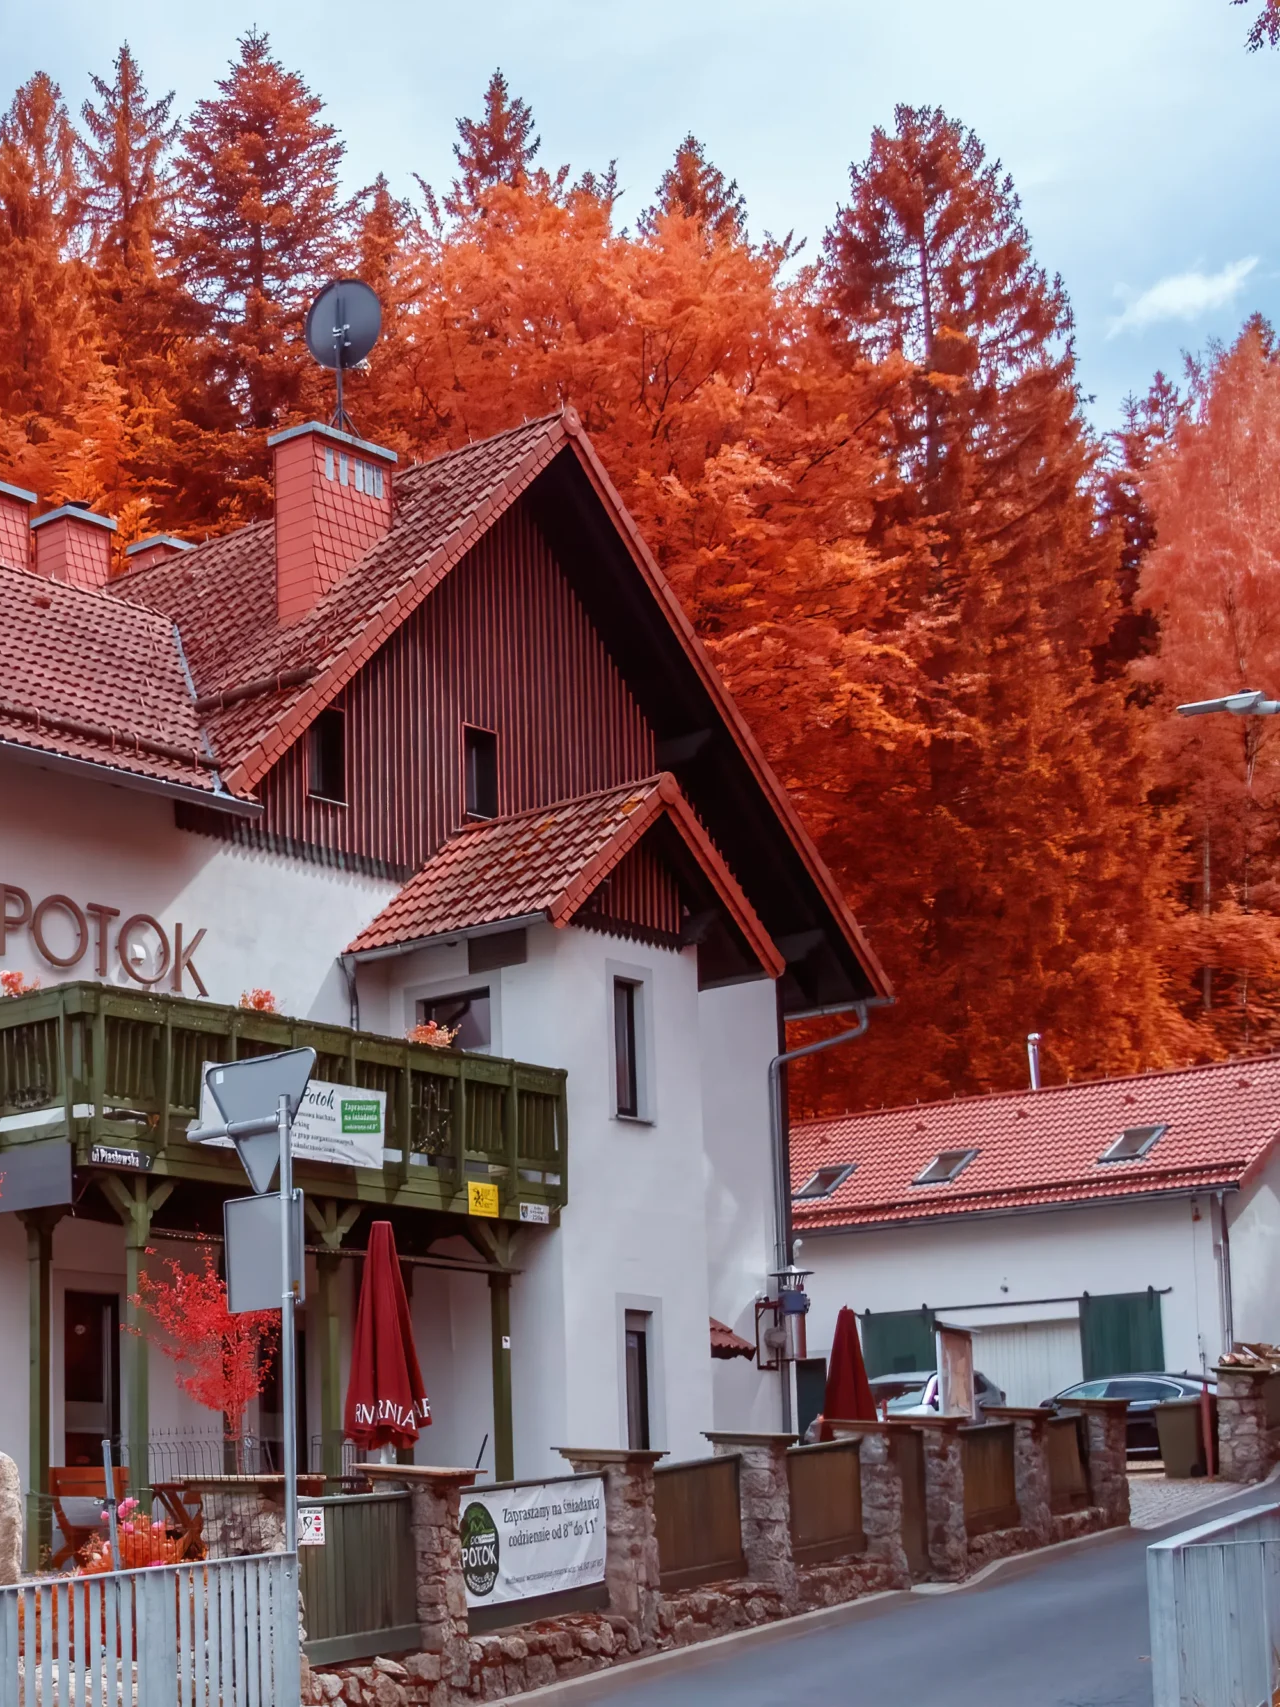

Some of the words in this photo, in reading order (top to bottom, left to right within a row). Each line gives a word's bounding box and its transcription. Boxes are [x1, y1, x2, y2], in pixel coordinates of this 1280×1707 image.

[502, 1505, 550, 1526] Zapraszamy
[552, 1504, 562, 1516] na
[563, 1496, 600, 1514] śniadania
[508, 1527, 550, 1547] codziennie
[551, 1523, 562, 1540] od
[573, 1520, 583, 1536] do
[461, 1543, 497, 1568] POTOK
